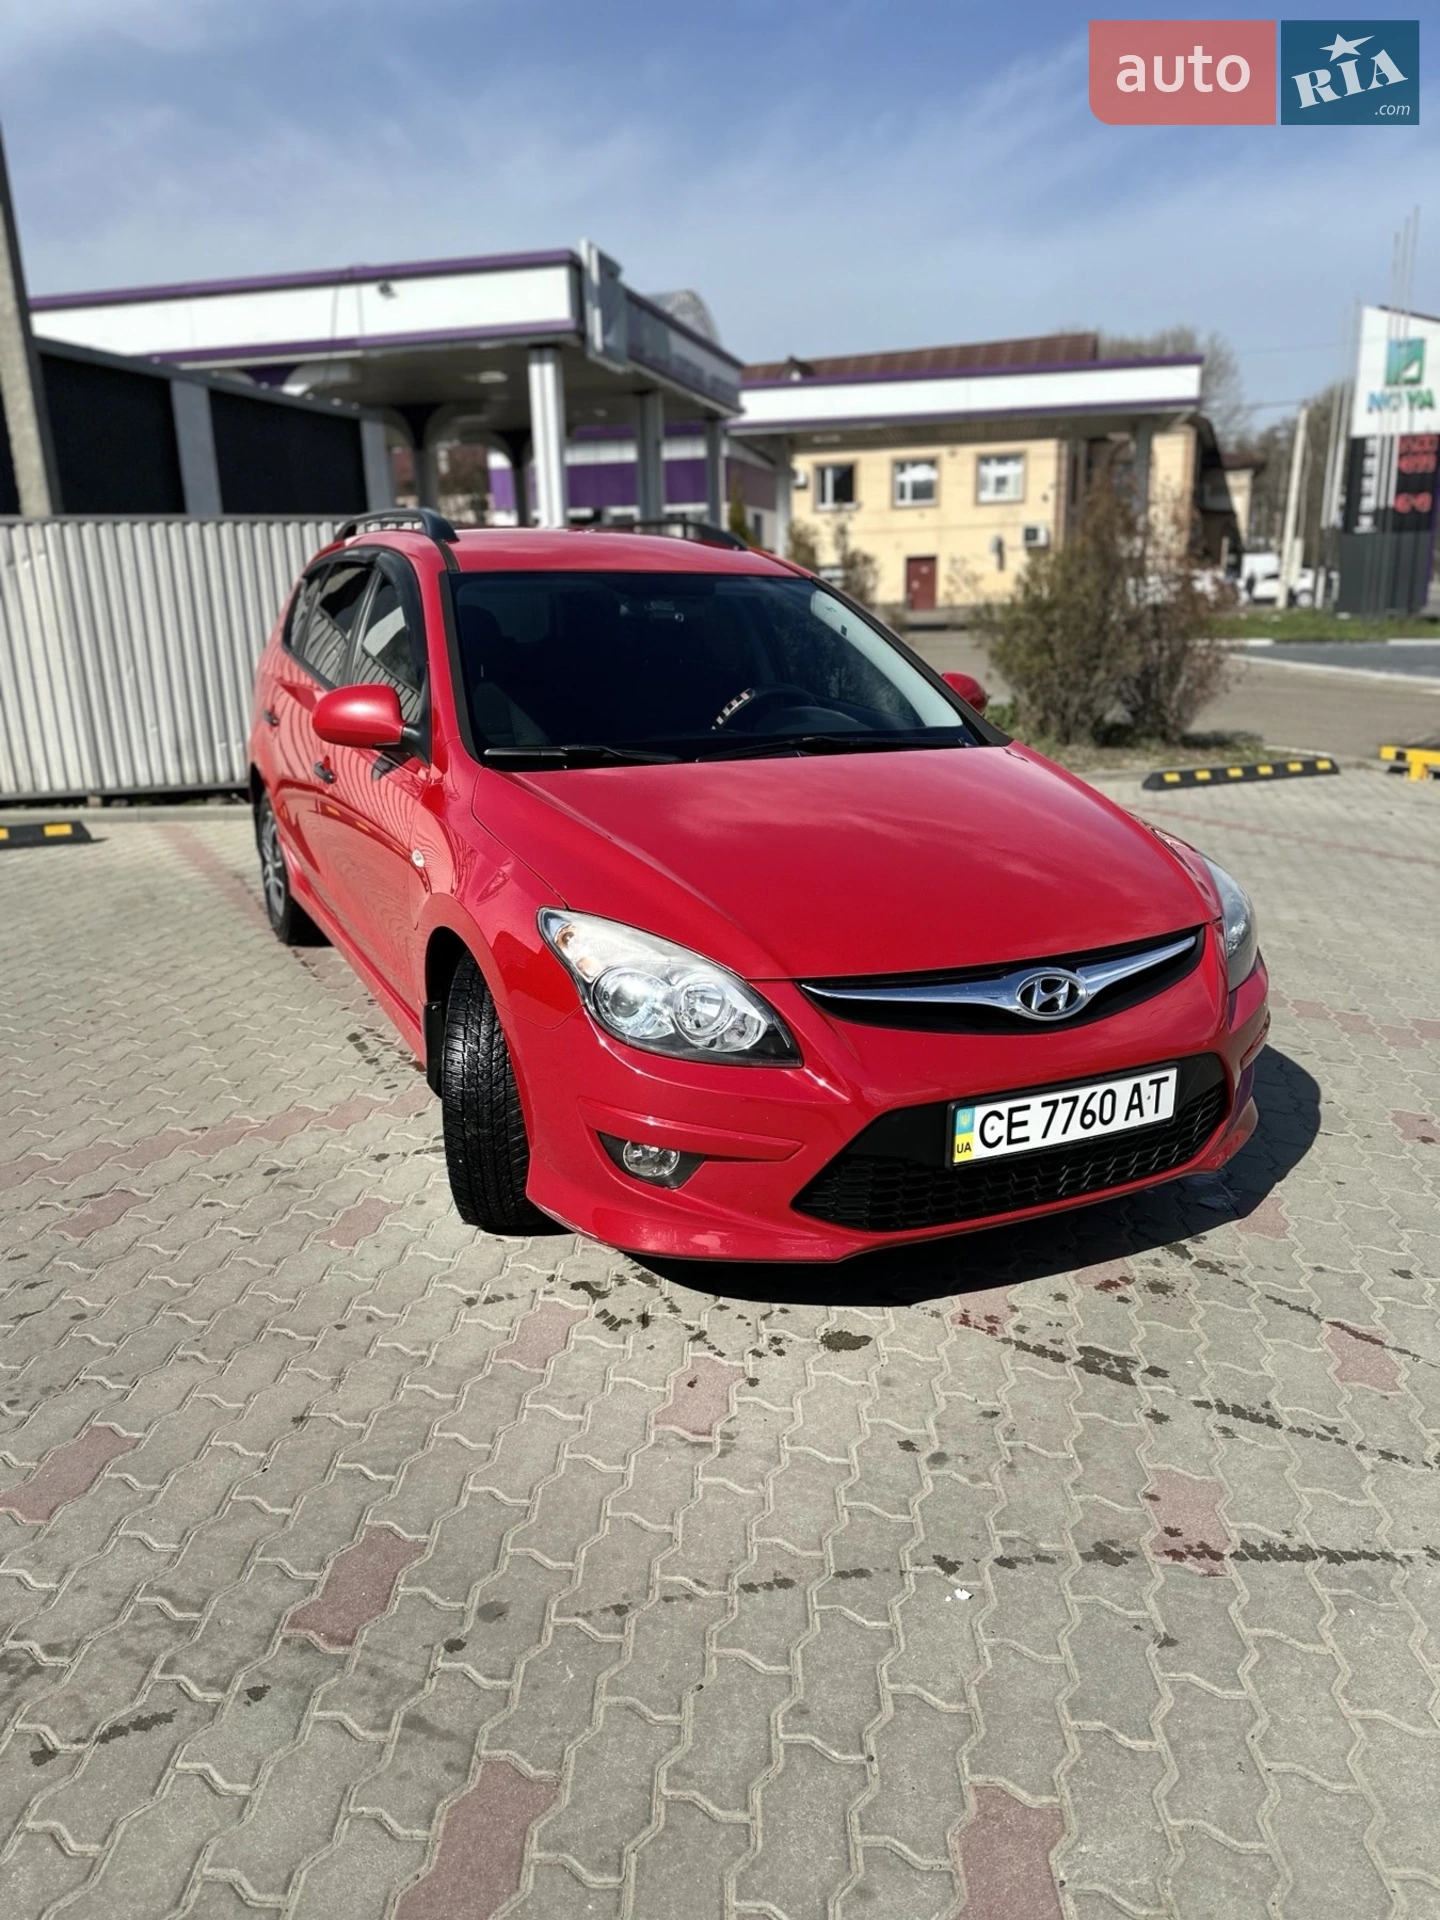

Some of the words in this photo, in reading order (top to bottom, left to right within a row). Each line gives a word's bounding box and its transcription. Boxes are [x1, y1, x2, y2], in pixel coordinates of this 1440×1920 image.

[979, 1104, 1031, 1149] CE
[1040, 1088, 1117, 1139] 7760
[1124, 1075, 1170, 1122] AT
[956, 1142, 972, 1154] UA
